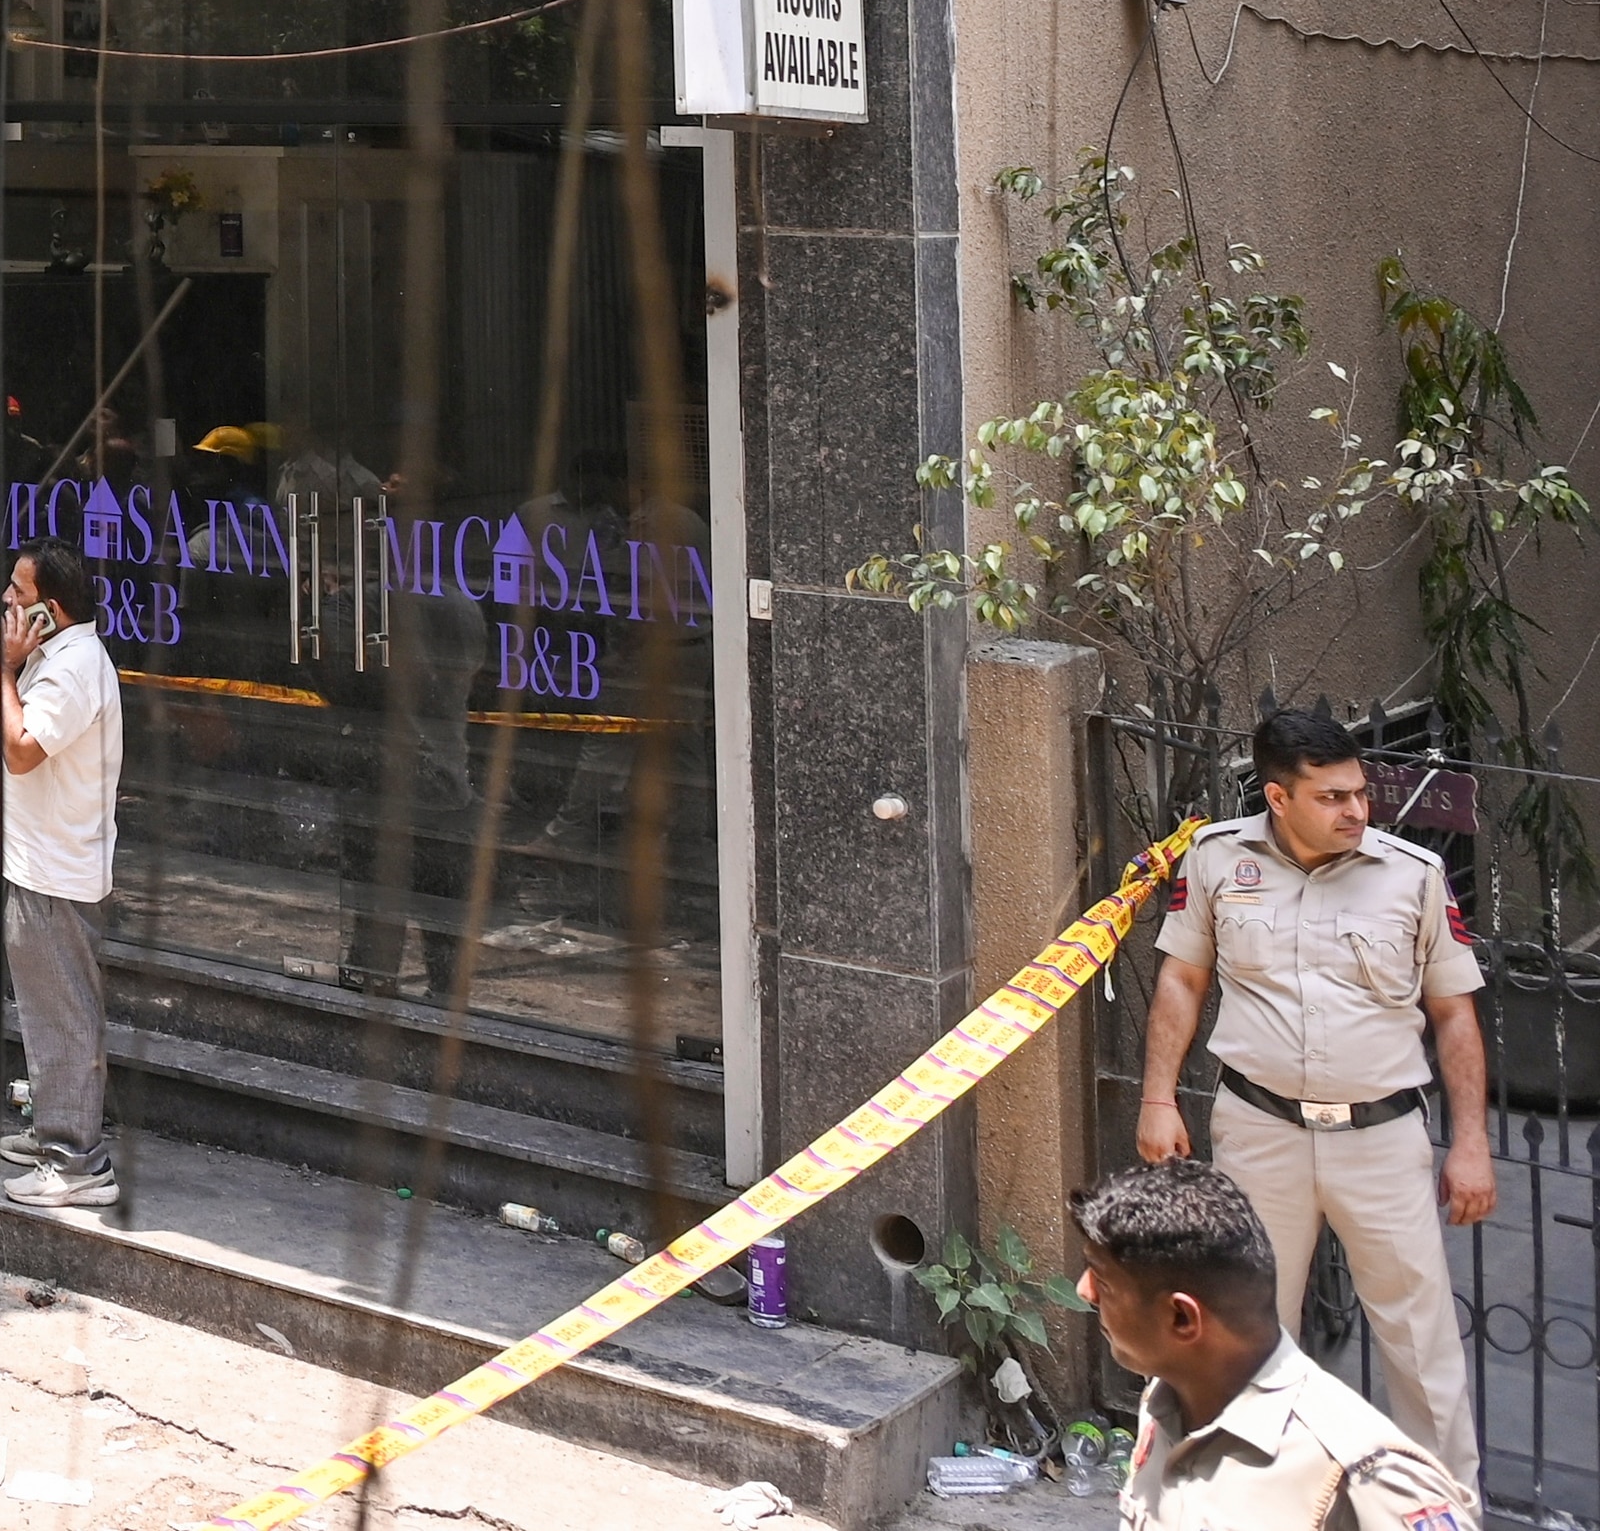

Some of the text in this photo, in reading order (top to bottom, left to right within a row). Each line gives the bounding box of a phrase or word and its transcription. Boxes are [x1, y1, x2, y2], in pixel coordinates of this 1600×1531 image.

[764, 31, 860, 90] AVAILABLE
[496, 622, 600, 701] B&B
[1063, 953, 1089, 977] POLICE
[1031, 974, 1053, 994] CROSS
[884, 1091, 910, 1111] DELHI
[787, 1164, 816, 1186] DELHI
[677, 1242, 709, 1261] DELHI
[554, 1321, 591, 1342] DELHI
[410, 1404, 450, 1427] DELHI
